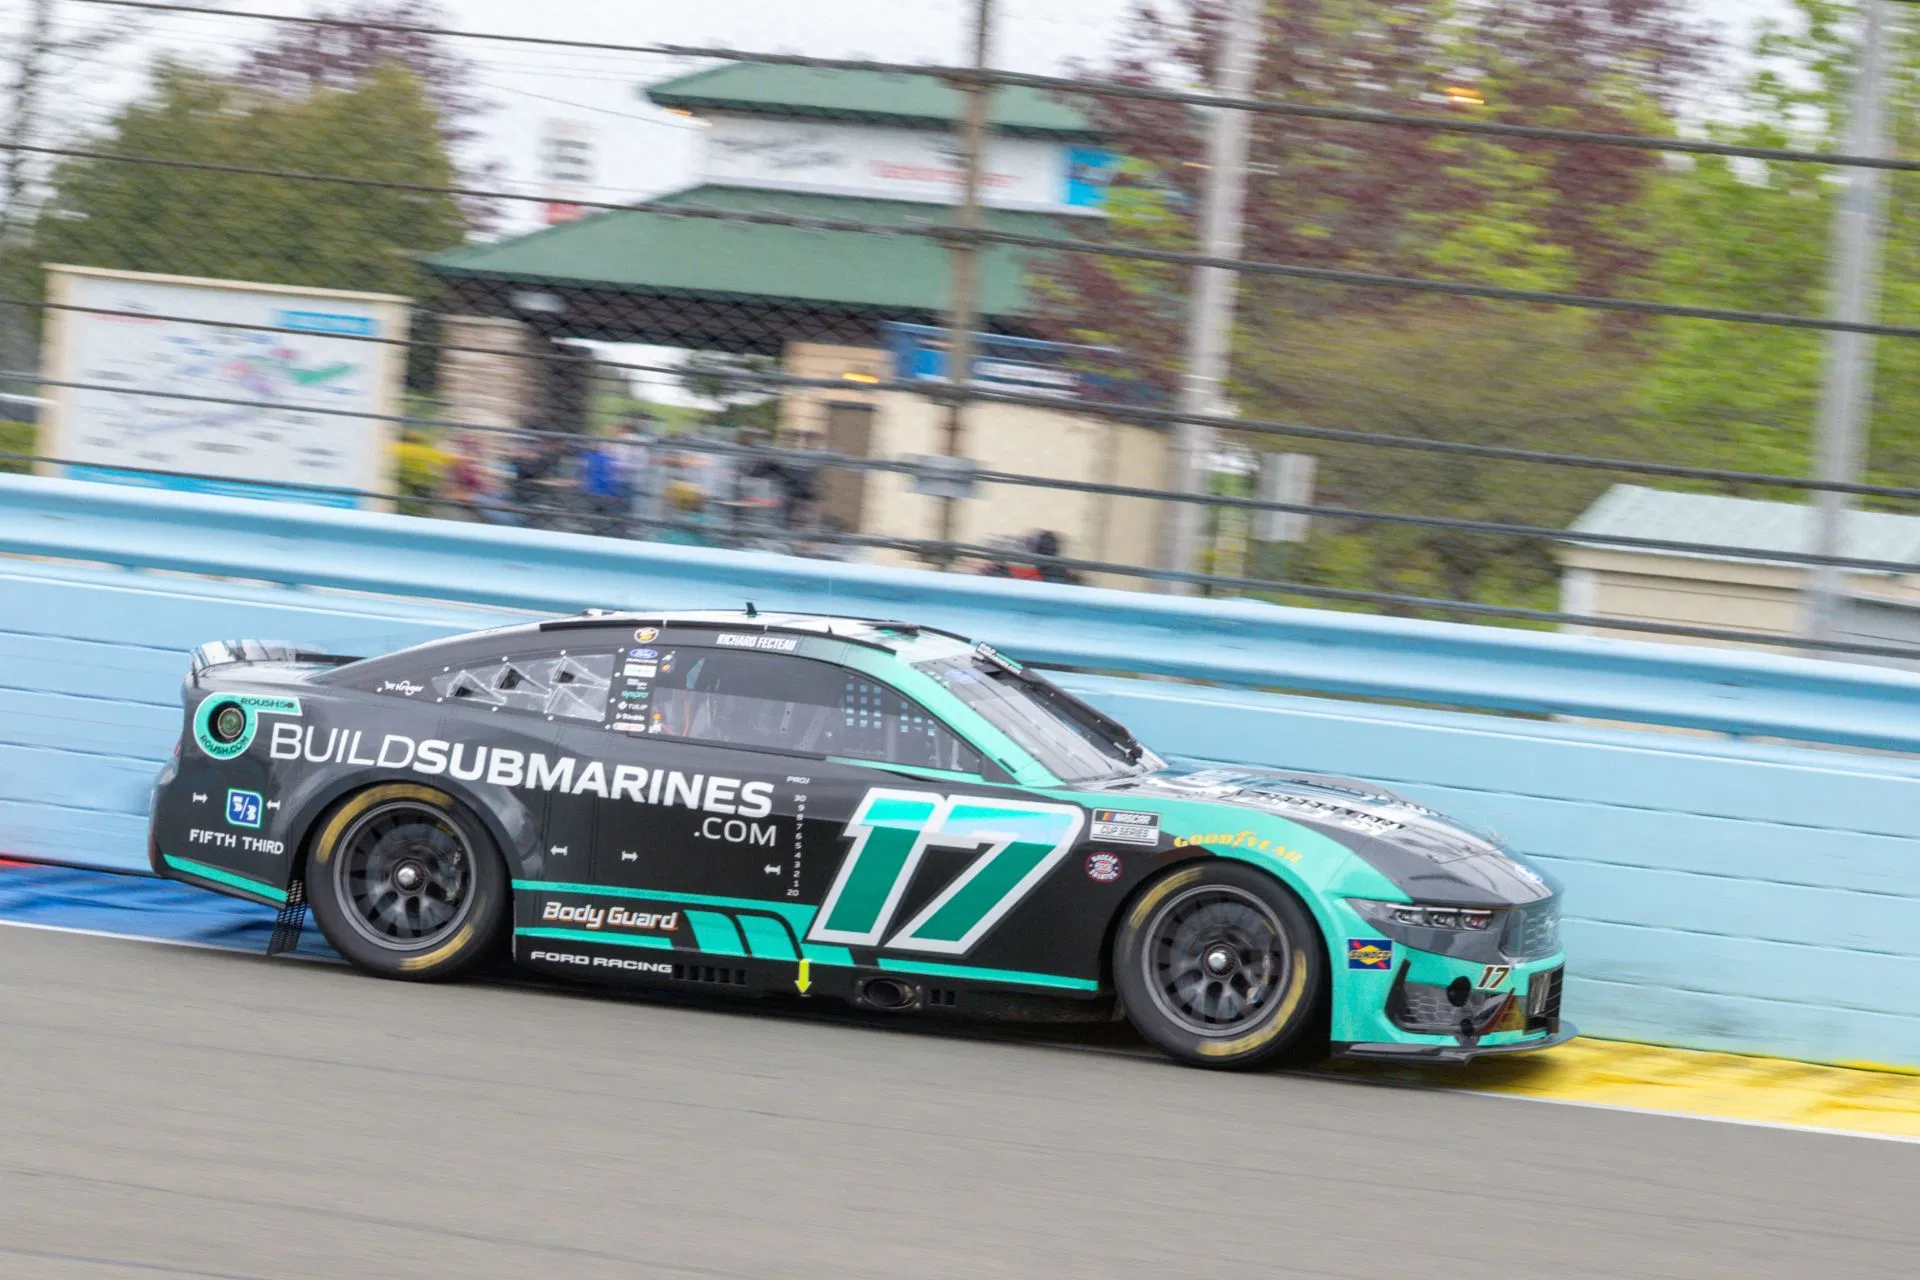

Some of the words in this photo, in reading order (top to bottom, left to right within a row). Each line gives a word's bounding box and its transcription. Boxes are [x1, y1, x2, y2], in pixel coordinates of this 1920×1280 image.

[716, 633, 758, 648] RICHARD
[757, 636, 797, 651] FECTEAU
[395, 680, 425, 696] Kroger
[199, 734, 250, 755] ROUSH.COM
[269, 721, 775, 819] BUILDSUBMARINES
[786, 776, 811, 784] PROJ
[189, 829, 236, 848] FIFTH
[242, 836, 284, 855] THIRD
[693, 817, 778, 847] .COM
[1100, 825, 1118, 835] CUP
[1118, 827, 1150, 838] SERIES
[1173, 830, 1304, 864] GOODYEAR
[793, 870, 800, 878] 2
[807, 787, 1086, 956] 17
[786, 889, 800, 897] 20
[542, 901, 604, 930] Body
[607, 906, 679, 932] Guard
[531, 951, 588, 965] FORD
[592, 956, 673, 973] RACING
[1349, 949, 1392, 960] SUNOCO
[1475, 965, 1512, 990] 17
